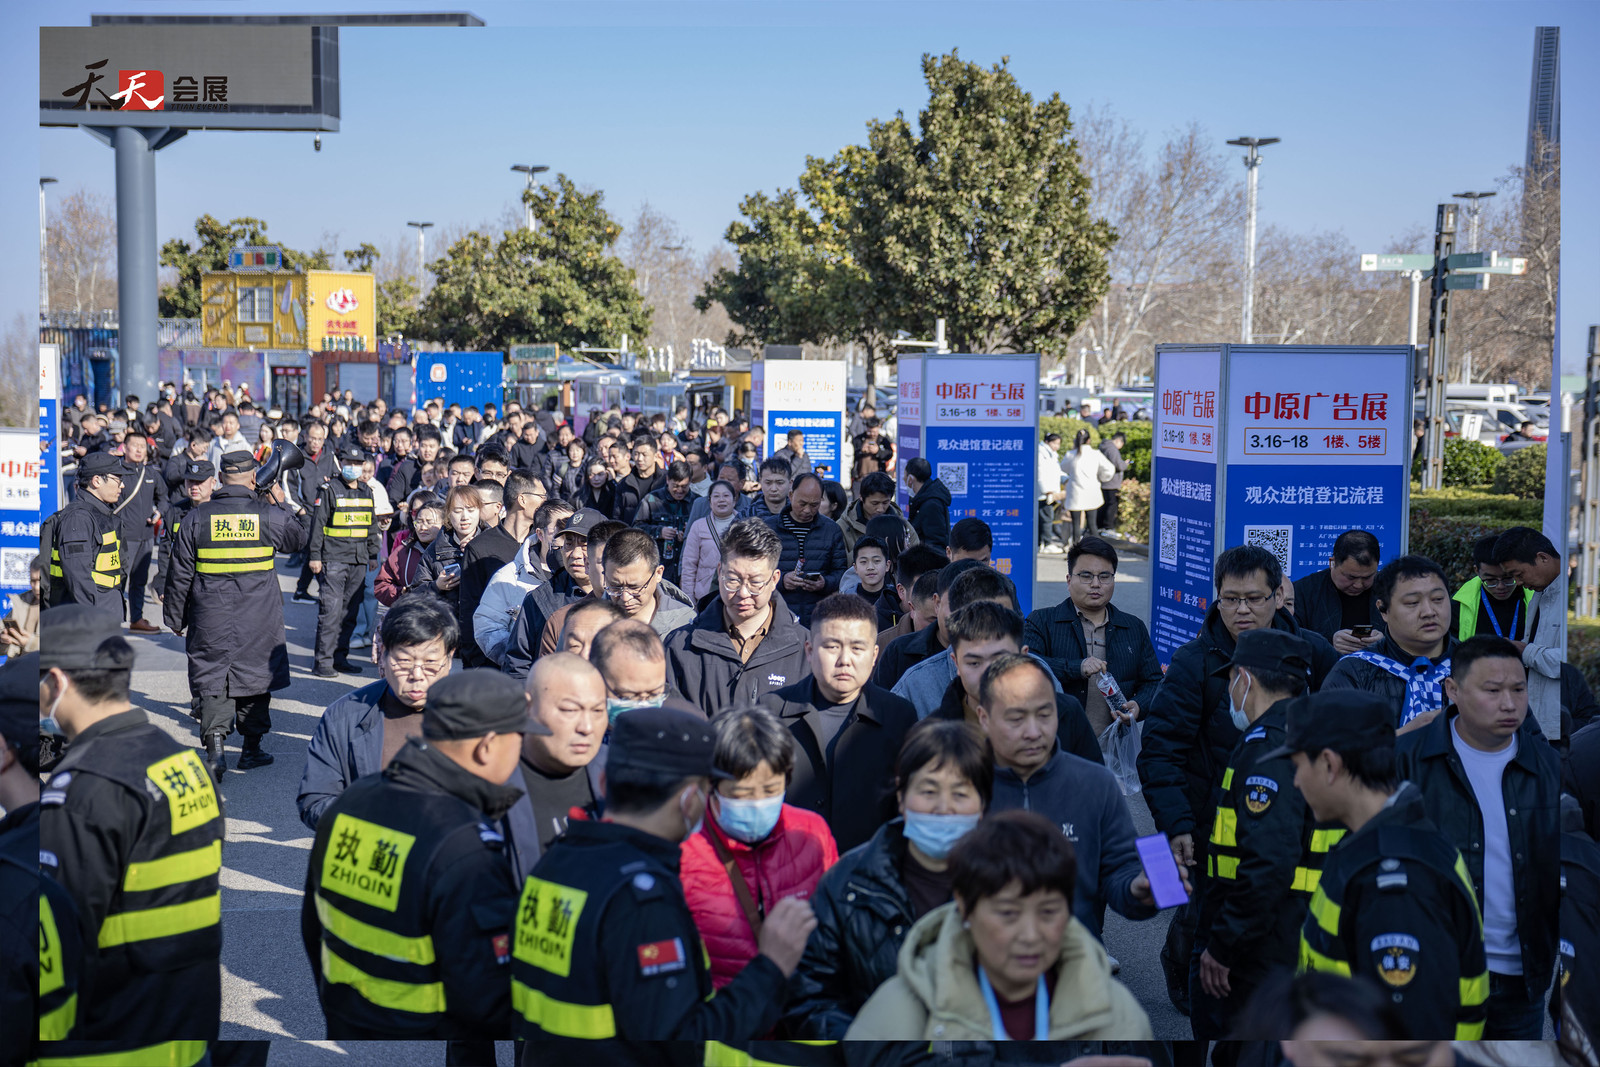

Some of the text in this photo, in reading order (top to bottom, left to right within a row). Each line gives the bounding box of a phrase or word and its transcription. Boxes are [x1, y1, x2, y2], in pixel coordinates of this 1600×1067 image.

[936, 383, 1025, 400] 中原广告展
[940, 408, 977, 417] 3.16-18
[1163, 389, 1215, 418] 中原广告展
[1245, 392, 1388, 420] 中原广告展
[937, 439, 1024, 450] 观众进馆登记流程
[1164, 429, 1185, 443] 3.16-18
[1250, 434, 1382, 449] 3.16-18 1楼、5楼
[1161, 477, 1212, 502] 观众进馆登记流程
[1245, 486, 1384, 504] 观众进馆登记流程
[215, 519, 255, 531] 执勤
[768, 673, 786, 683] Jeep
[334, 827, 399, 879] 执勤
[329, 863, 393, 899] ZHIQIN
[522, 887, 572, 939] 执勤
[519, 929, 566, 961] ZHIQIN
